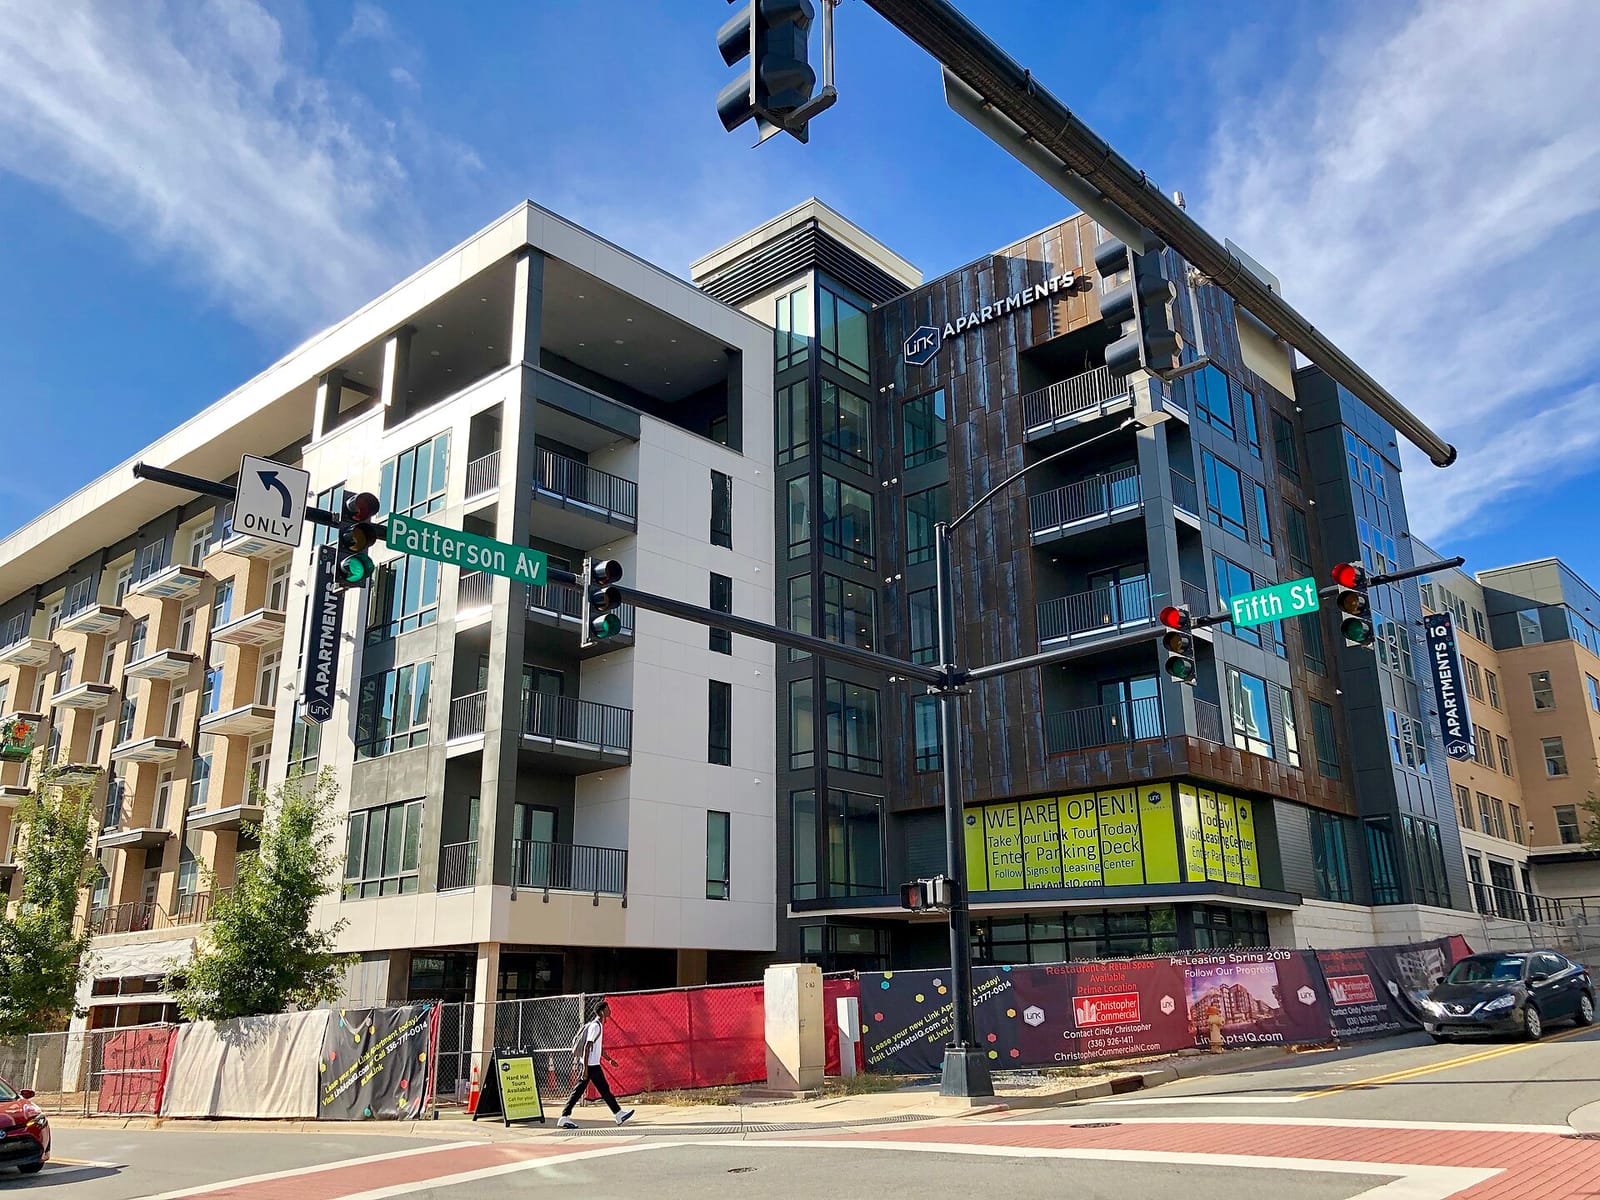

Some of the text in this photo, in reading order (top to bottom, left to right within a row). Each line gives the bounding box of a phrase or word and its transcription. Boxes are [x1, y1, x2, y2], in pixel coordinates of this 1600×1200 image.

[942, 270, 1075, 339] APARTMENTS
[243, 513, 294, 538] ONLY
[391, 519, 540, 580] Patterson Av
[1233, 583, 1316, 625] Fifth St
[315, 582, 339, 696] APARTMENTS
[1430, 625, 1448, 638] IQ
[1435, 642, 1462, 737] APARTMENTS
[986, 791, 1135, 829] WE ARE OPEN!
[1203, 794, 1228, 812] Tour
[1201, 811, 1233, 833] Today!
[987, 821, 1139, 848] Take Your Link Tour Today
[1184, 825, 1202, 842] Visit
[1229, 834, 1253, 851] Center
[992, 837, 1140, 866] Enter Parking Deck
[995, 858, 1136, 879] Follow Signs to Leasing Center
[1045, 962, 1099, 975] Restaurant
[1109, 960, 1131, 971] Retail
[1133, 959, 1155, 970] Space
[1170, 951, 1291, 967] Pre-Leasing Spring 2019
[1090, 972, 1125, 982] Available
[1184, 964, 1275, 978] Follow Our Progress
[972, 980, 1012, 1007] 6-777-0014
[977, 975, 1001, 993] today!
[1077, 982, 1137, 995] Prime Location
[1095, 998, 1137, 1012] Christopher
[1096, 1009, 1138, 1022] Commercial
[398, 1015, 418, 1034] today!
[870, 1036, 892, 1054] Lease
[892, 1026, 909, 1042] your
[908, 1019, 925, 1031] new
[924, 1009, 940, 1023] Link
[928, 1023, 956, 1044] #LiveLi
[1063, 1023, 1152, 1039] Contact Cindy Christopher
[867, 1051, 886, 1065] Visit
[886, 1021, 941, 1056] LinkAptsIQ.com
[940, 1016, 949, 1025] or
[1087, 1038, 1106, 1049] (336)
[1194, 1031, 1285, 1046] LinAptsIQ.com
[1054, 1042, 1161, 1061] ChristopherCommercialNC.com
